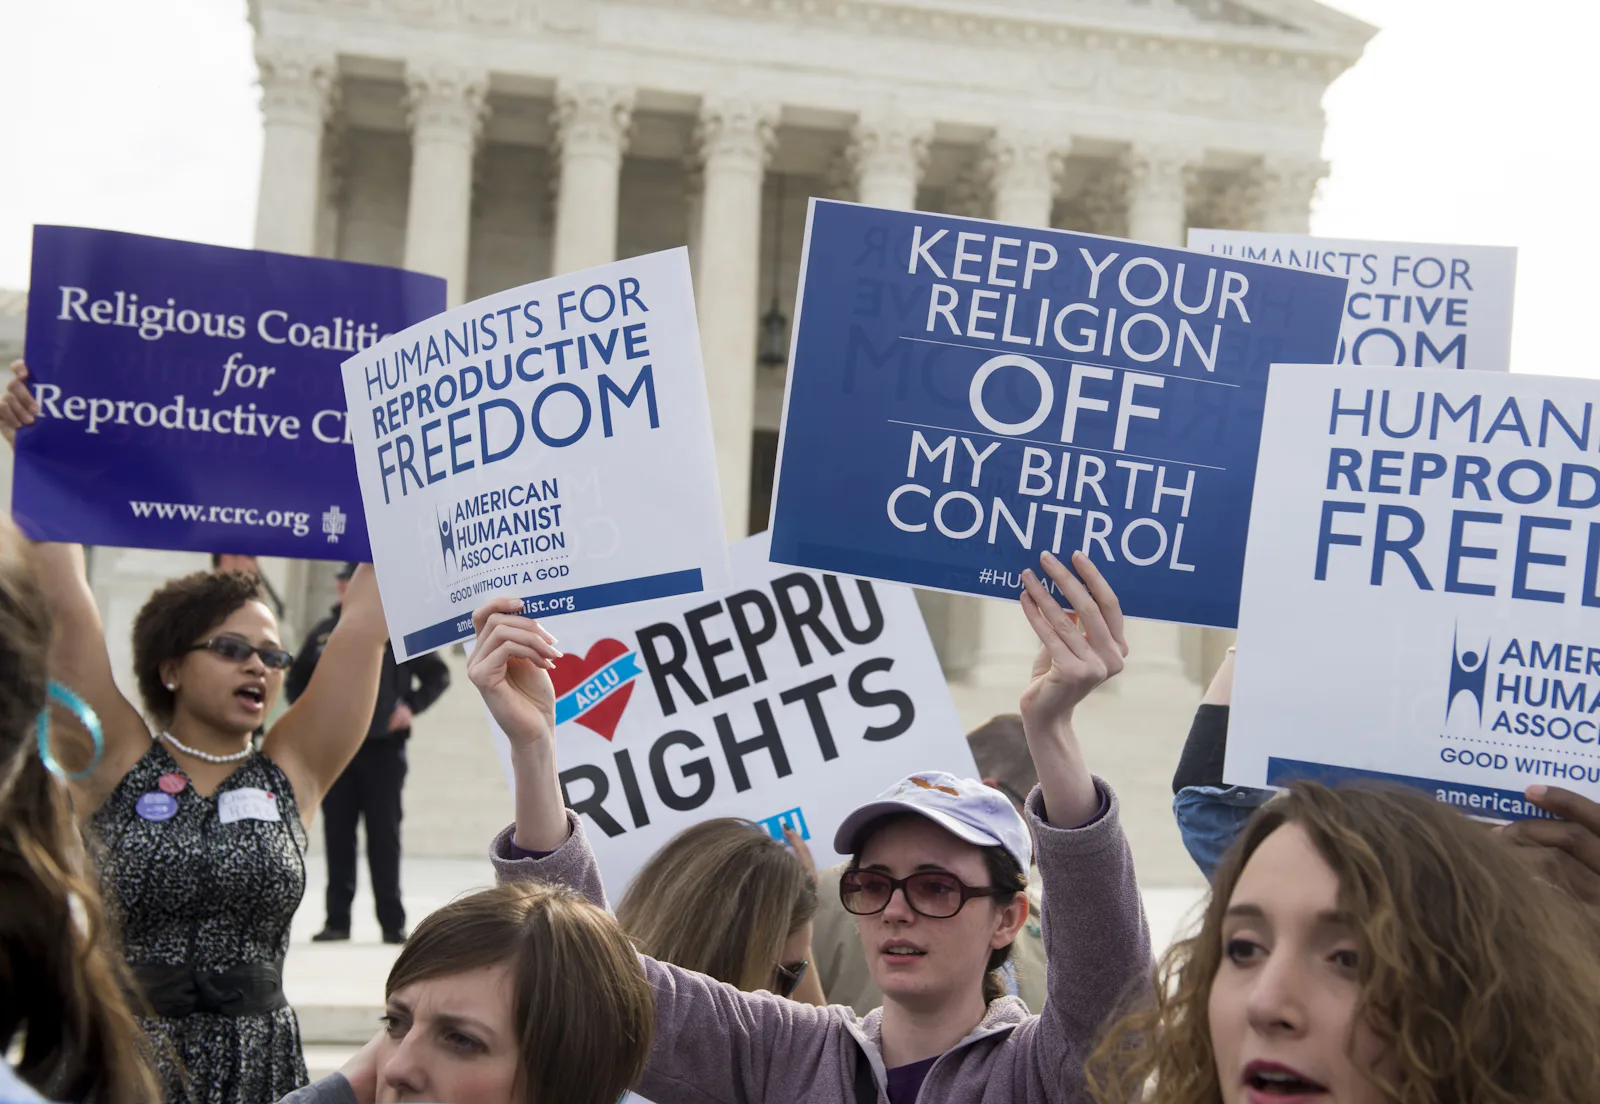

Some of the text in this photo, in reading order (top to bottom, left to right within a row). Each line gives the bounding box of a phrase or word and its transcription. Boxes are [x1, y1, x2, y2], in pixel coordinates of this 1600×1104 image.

[907, 225, 1059, 290] KEEP
[1079, 248, 1251, 324] YOUR
[1392, 256, 1473, 291] FOR
[57, 286, 395, 353] Religious Coaliti
[364, 277, 649, 400] HUMANISTS FOR
[926, 283, 1222, 372] RELIGION
[213, 353, 275, 396] for
[372, 322, 650, 439] REPRODUCTIVE
[968, 354, 1165, 451] OFF
[33, 383, 299, 439] Reproductive
[377, 364, 660, 504] FREEDOM
[1329, 388, 1600, 452] HUMAN
[454, 478, 559, 524] AMERICAN
[906, 430, 1196, 518] MY BIRTH
[1326, 447, 1600, 509] REPROD
[129, 501, 309, 536] www.rcrc.org
[456, 504, 562, 550] HUMANIST
[886, 484, 1196, 573] CONTROL
[460, 532, 565, 572] ASSOCIATION
[450, 565, 570, 604] GOOD WITHOUT A GOD
[1499, 638, 1600, 676] AMER
[575, 667, 620, 711] ACLU
[558, 656, 916, 838] RIGHTS
[1440, 747, 1600, 784] GOOD WITHOU
